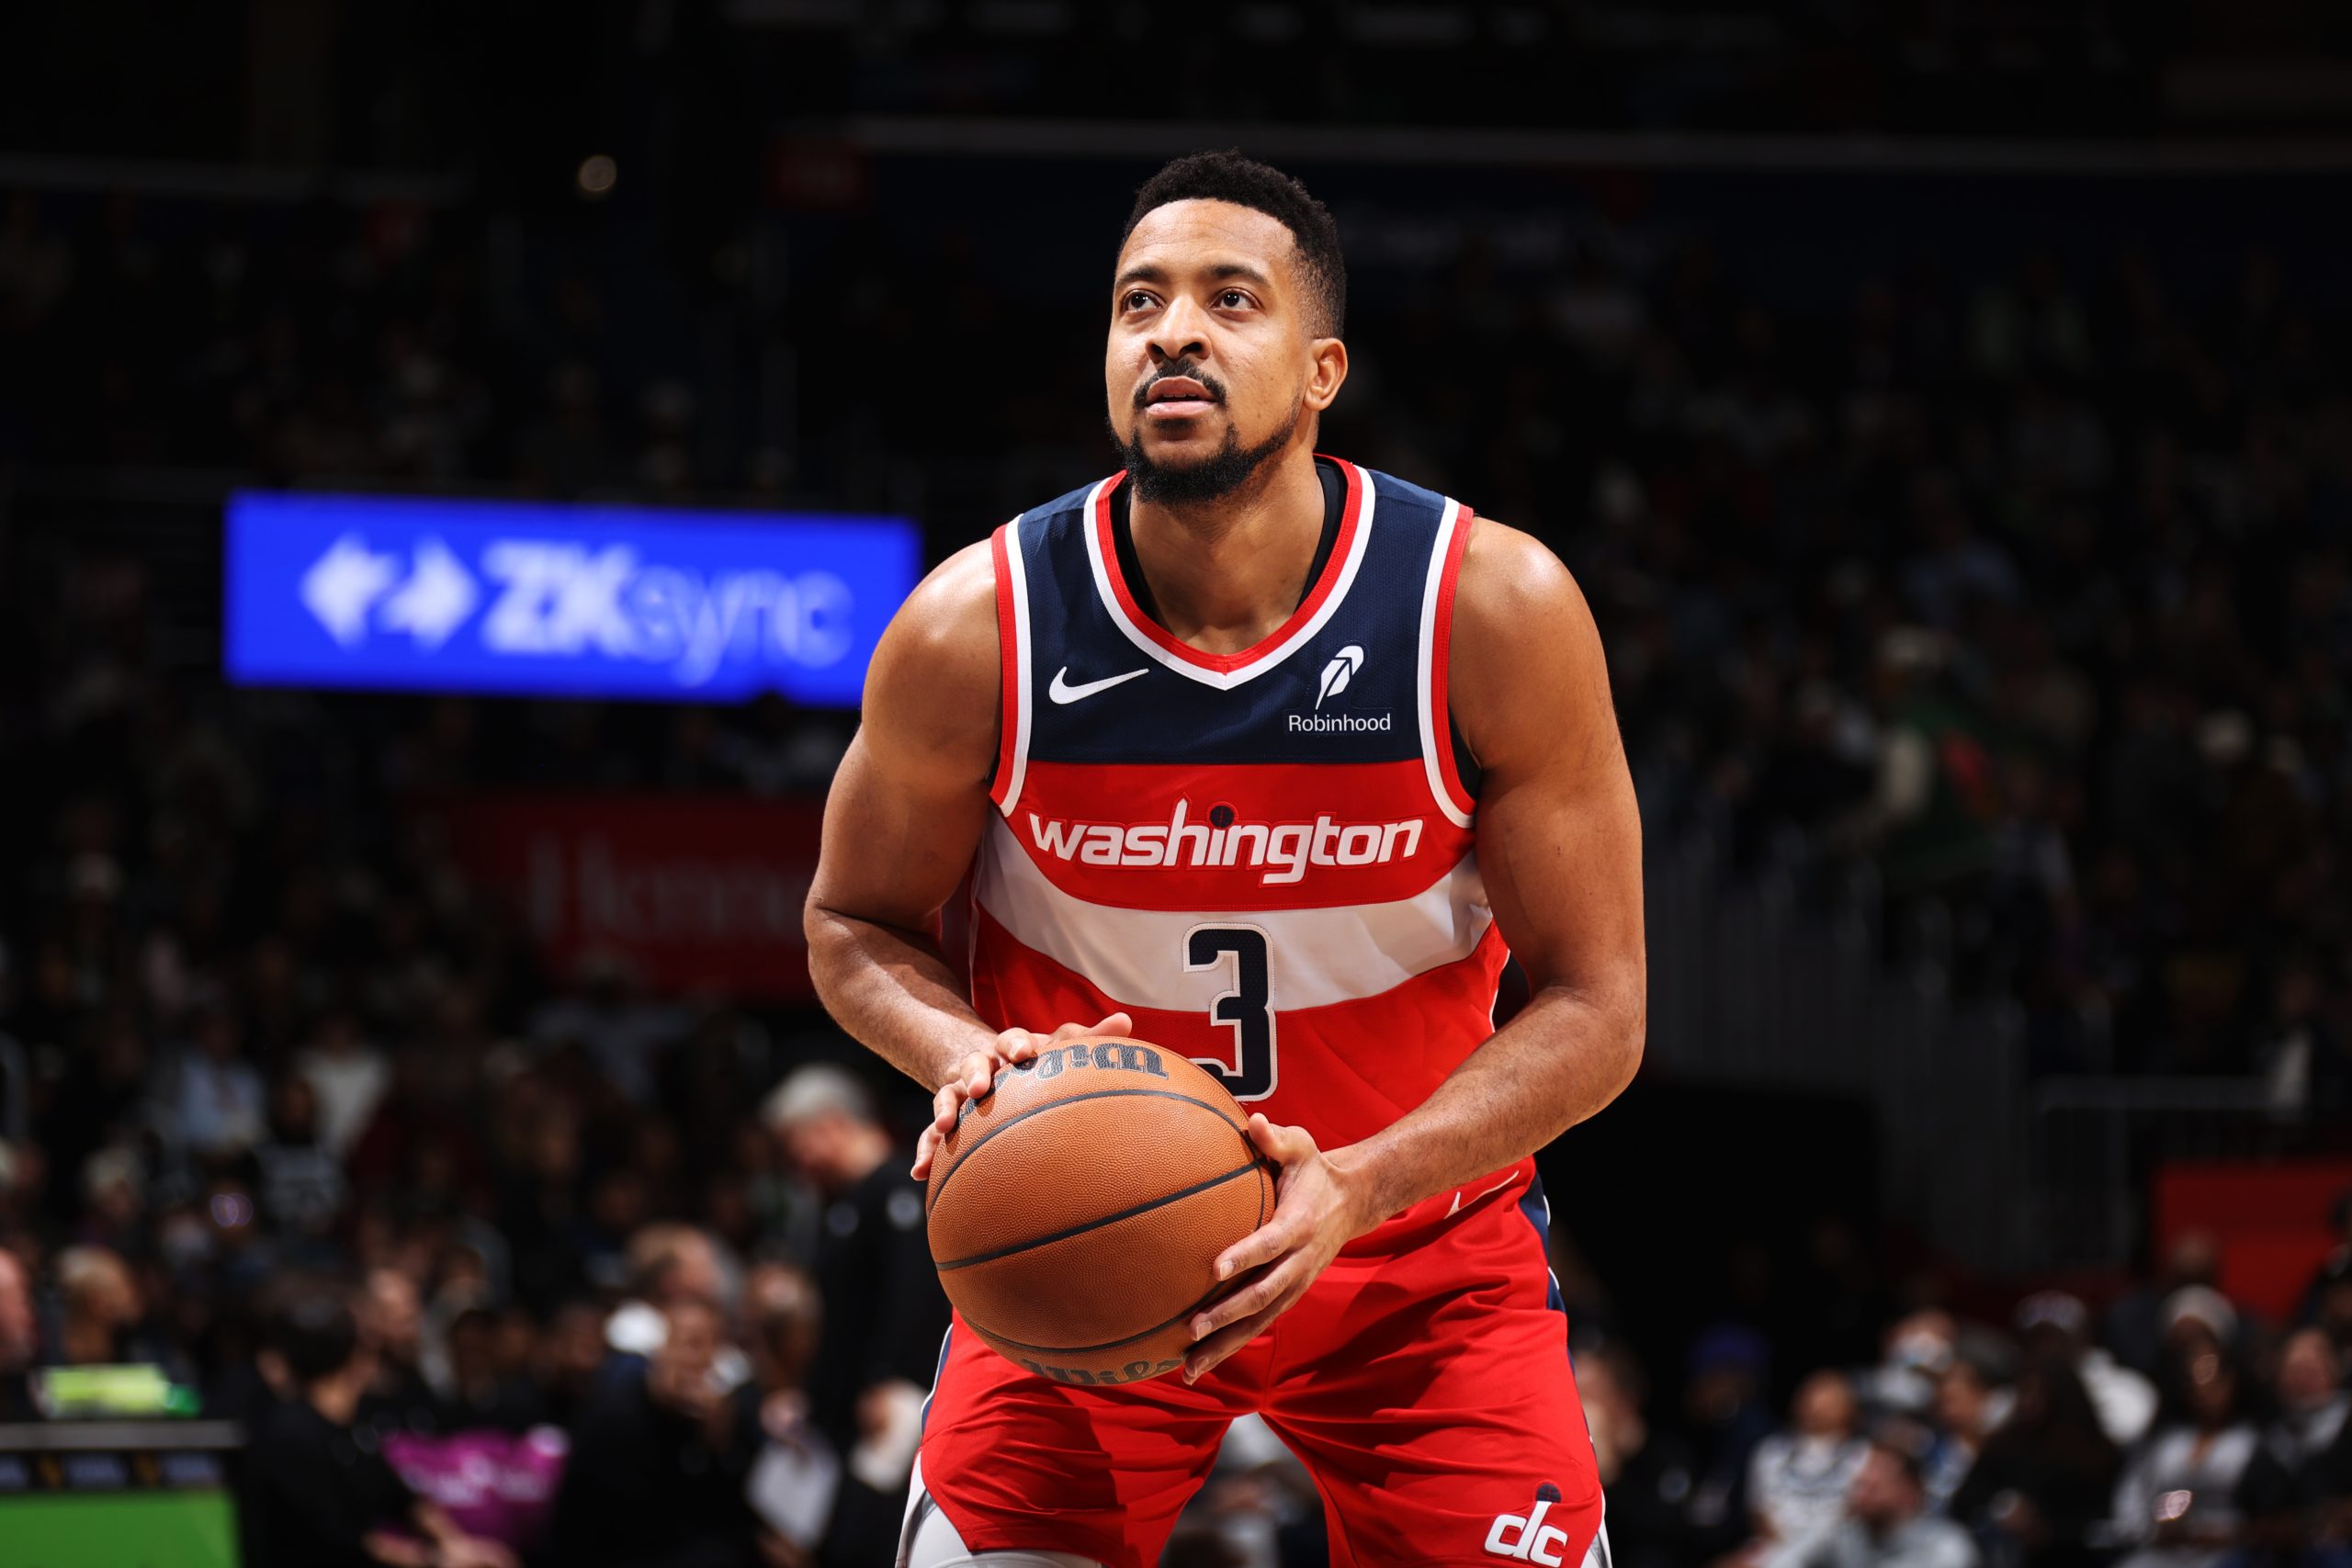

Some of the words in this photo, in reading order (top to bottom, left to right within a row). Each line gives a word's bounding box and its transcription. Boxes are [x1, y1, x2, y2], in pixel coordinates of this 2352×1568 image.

[480, 539, 854, 686] ZKsync
[1288, 712, 1391, 732] Robinhood
[1029, 797, 1423, 885] washington
[1182, 922, 1278, 1102] 3
[1484, 1483, 1568, 1568] dc
